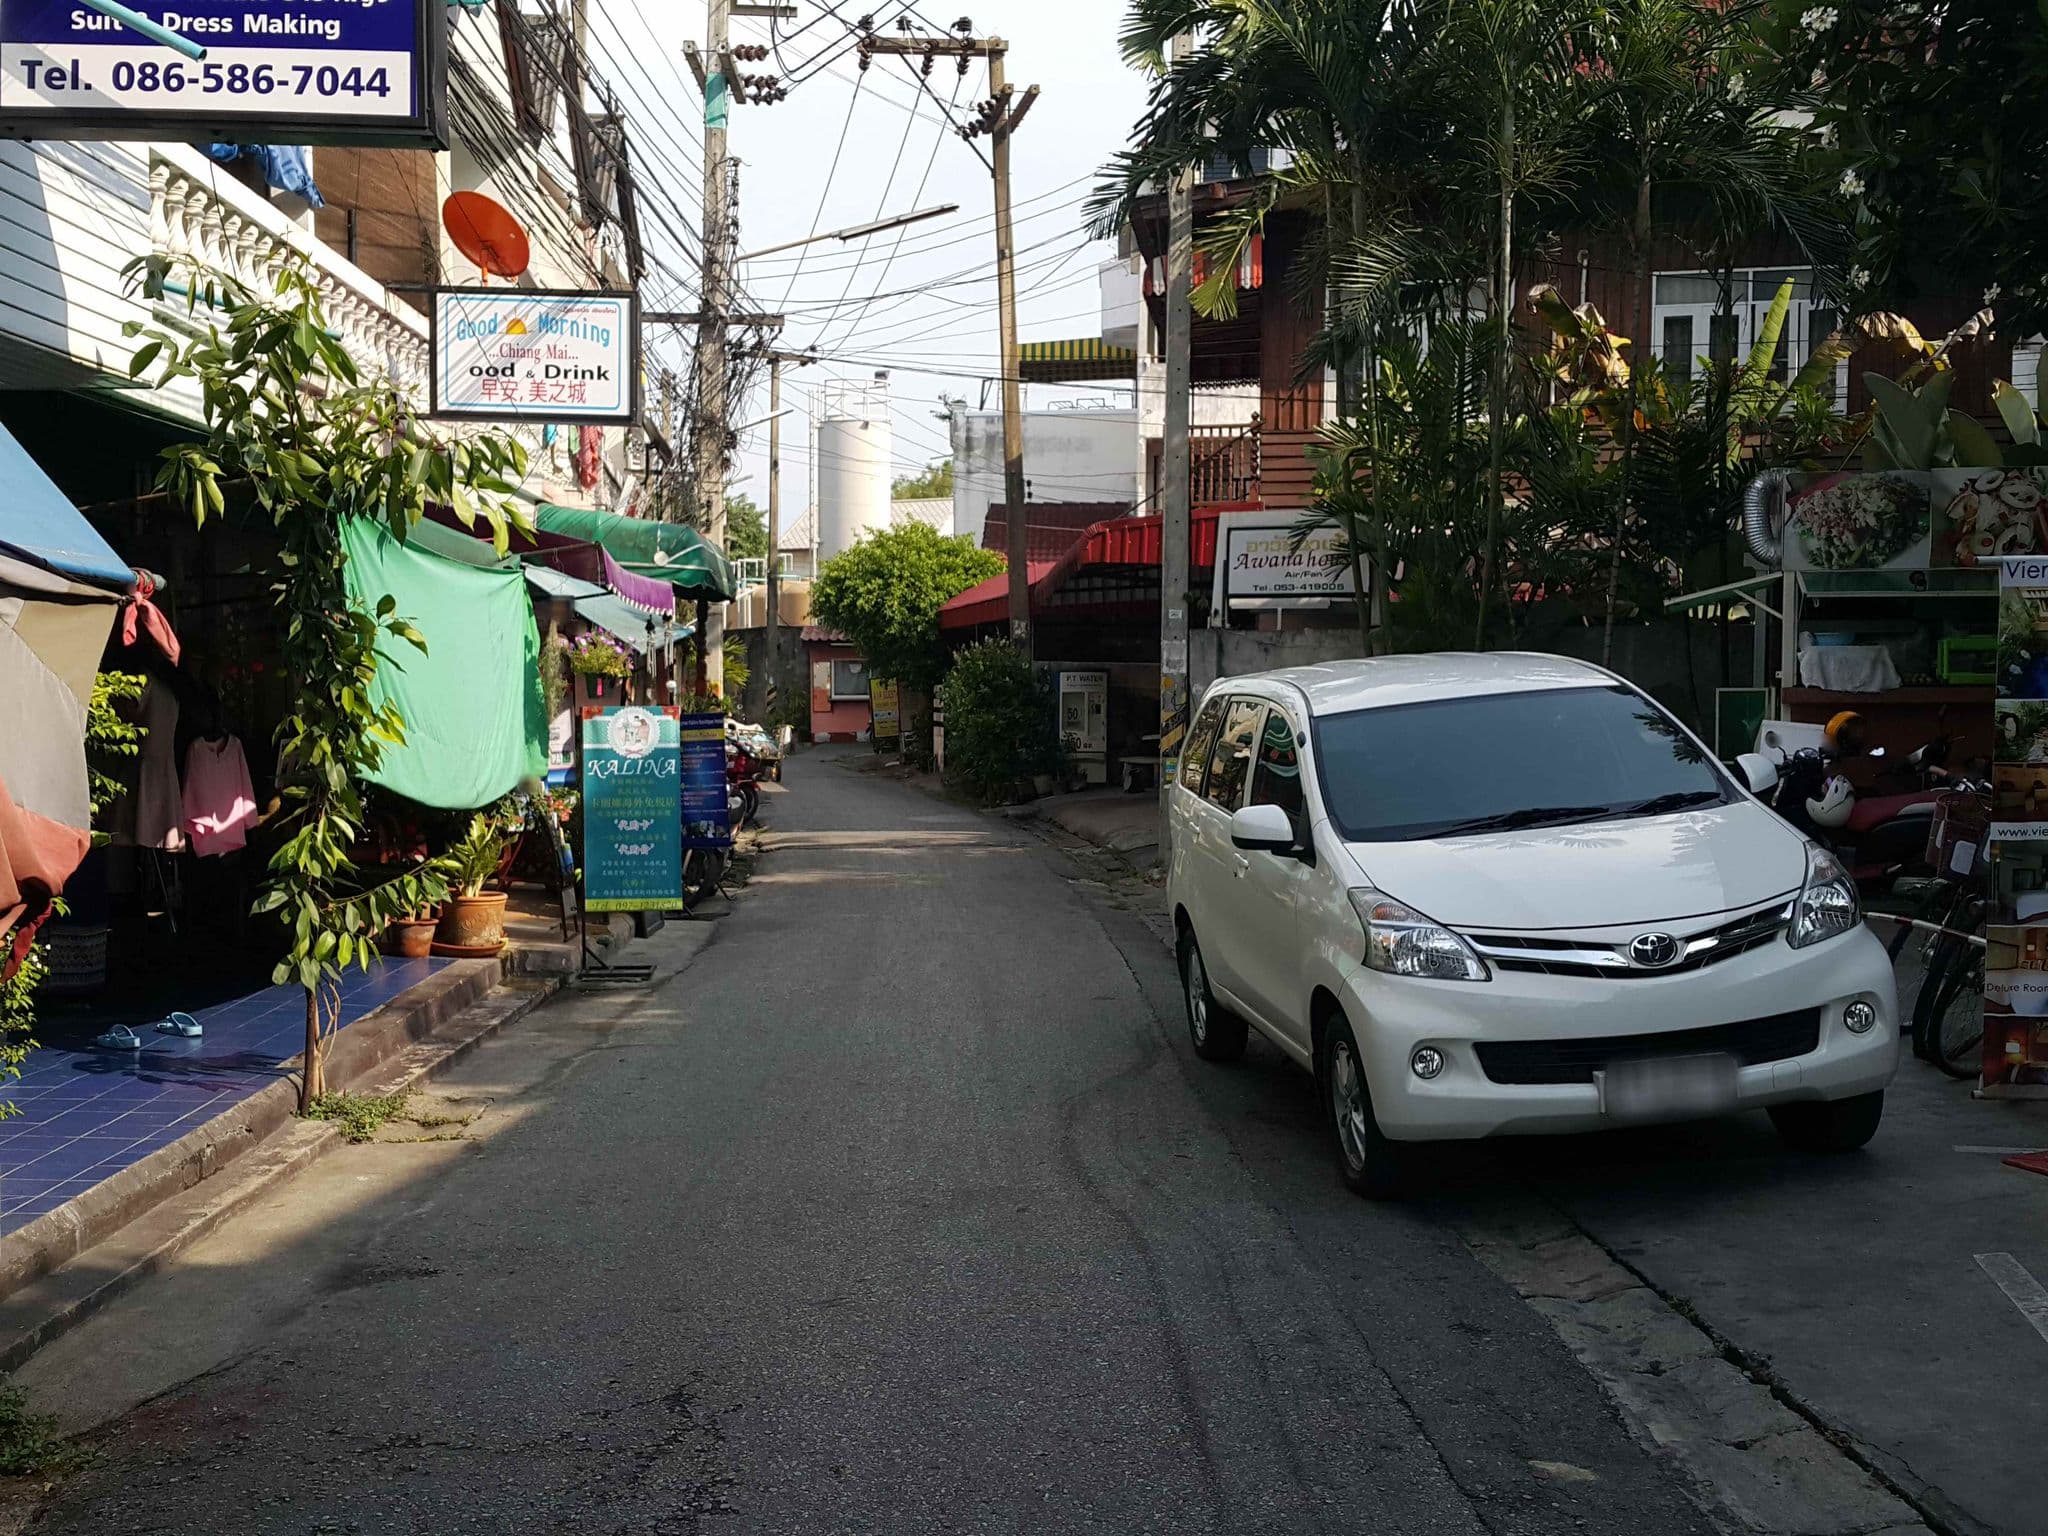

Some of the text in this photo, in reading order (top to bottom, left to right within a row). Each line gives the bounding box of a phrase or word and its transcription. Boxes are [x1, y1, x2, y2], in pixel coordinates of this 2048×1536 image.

[162, 12, 233, 33] Dress
[243, 13, 341, 40] Making
[20, 59, 391, 98] Tel. 086-586-7044
[456, 312, 611, 348] Good Morning
[526, 370, 535, 379] &
[544, 365, 610, 381] Drink
[1232, 552, 1303, 570] Awana
[1284, 570, 1323, 579] Air/Fan
[587, 757, 676, 779] KALINA
[1986, 982, 2020, 993] Deluxe
